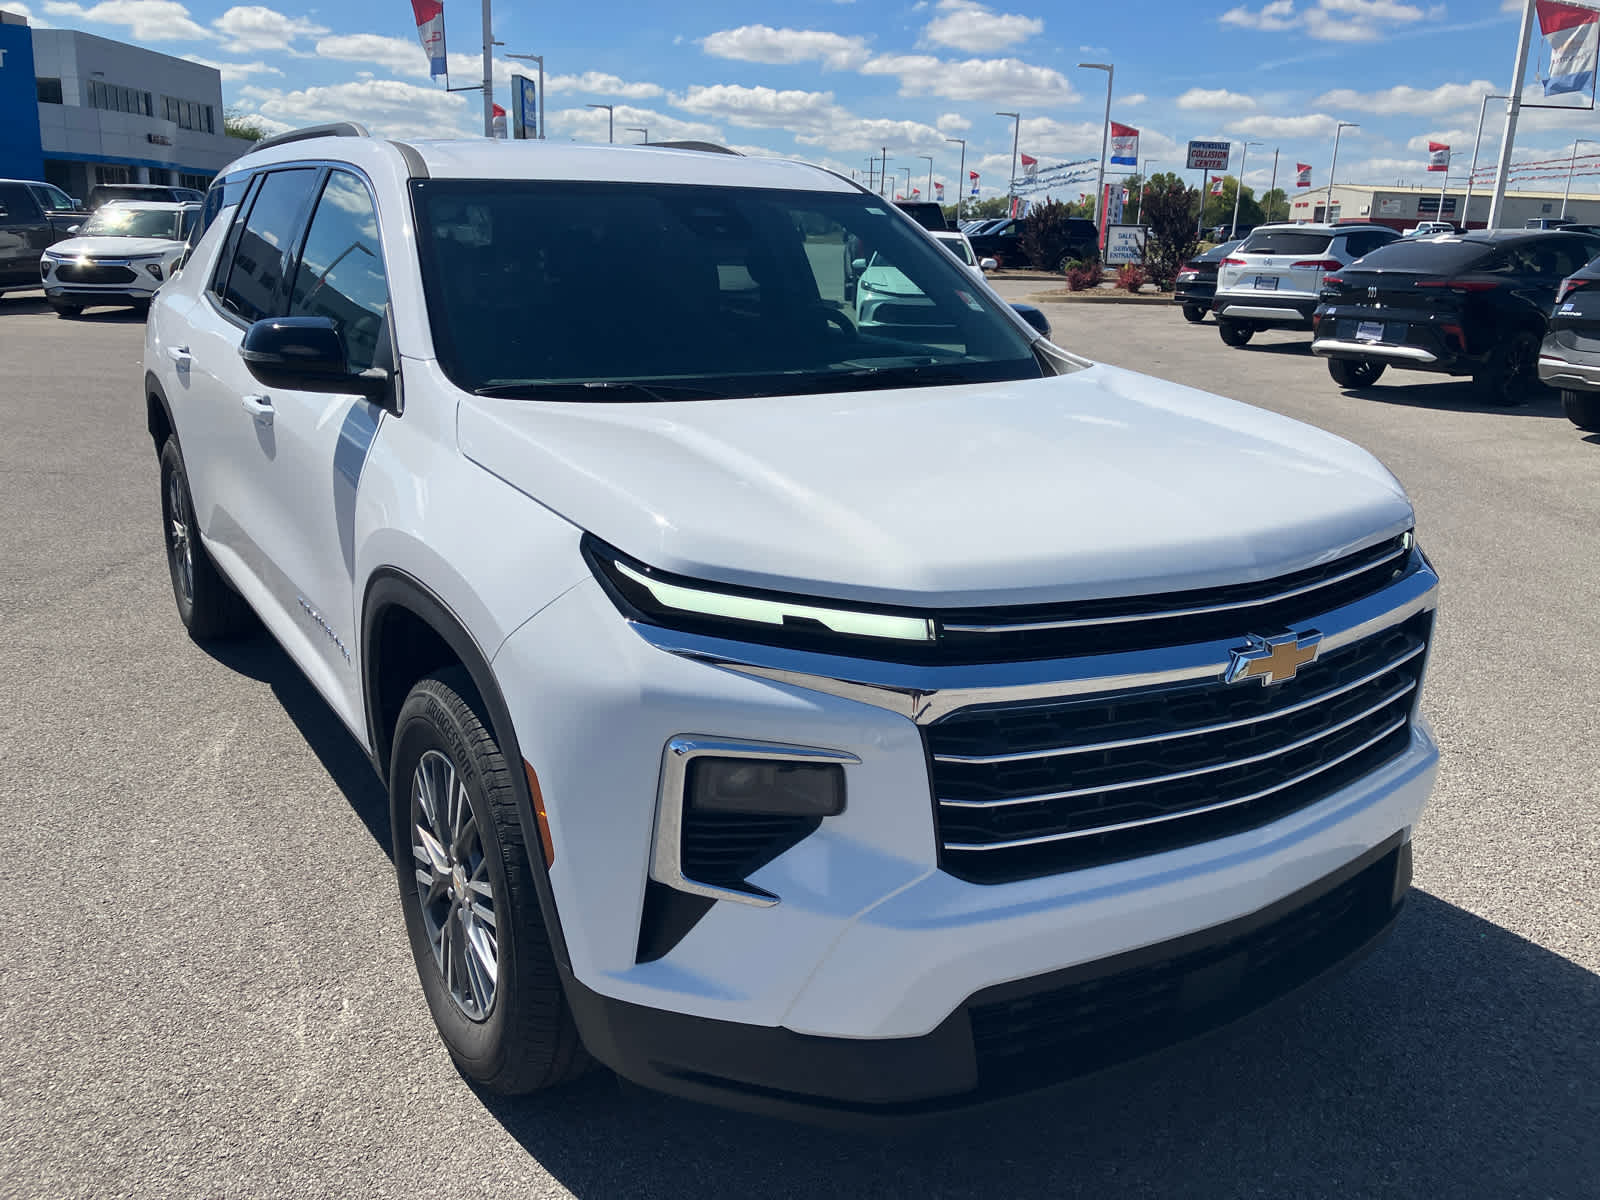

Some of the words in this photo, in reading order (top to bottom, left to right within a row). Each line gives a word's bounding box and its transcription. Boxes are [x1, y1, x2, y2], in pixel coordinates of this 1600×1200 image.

[1191, 150, 1227, 159] COLLISION
[1194, 159, 1222, 168] CENTER
[425, 698, 474, 784] BRIDGESTONE
